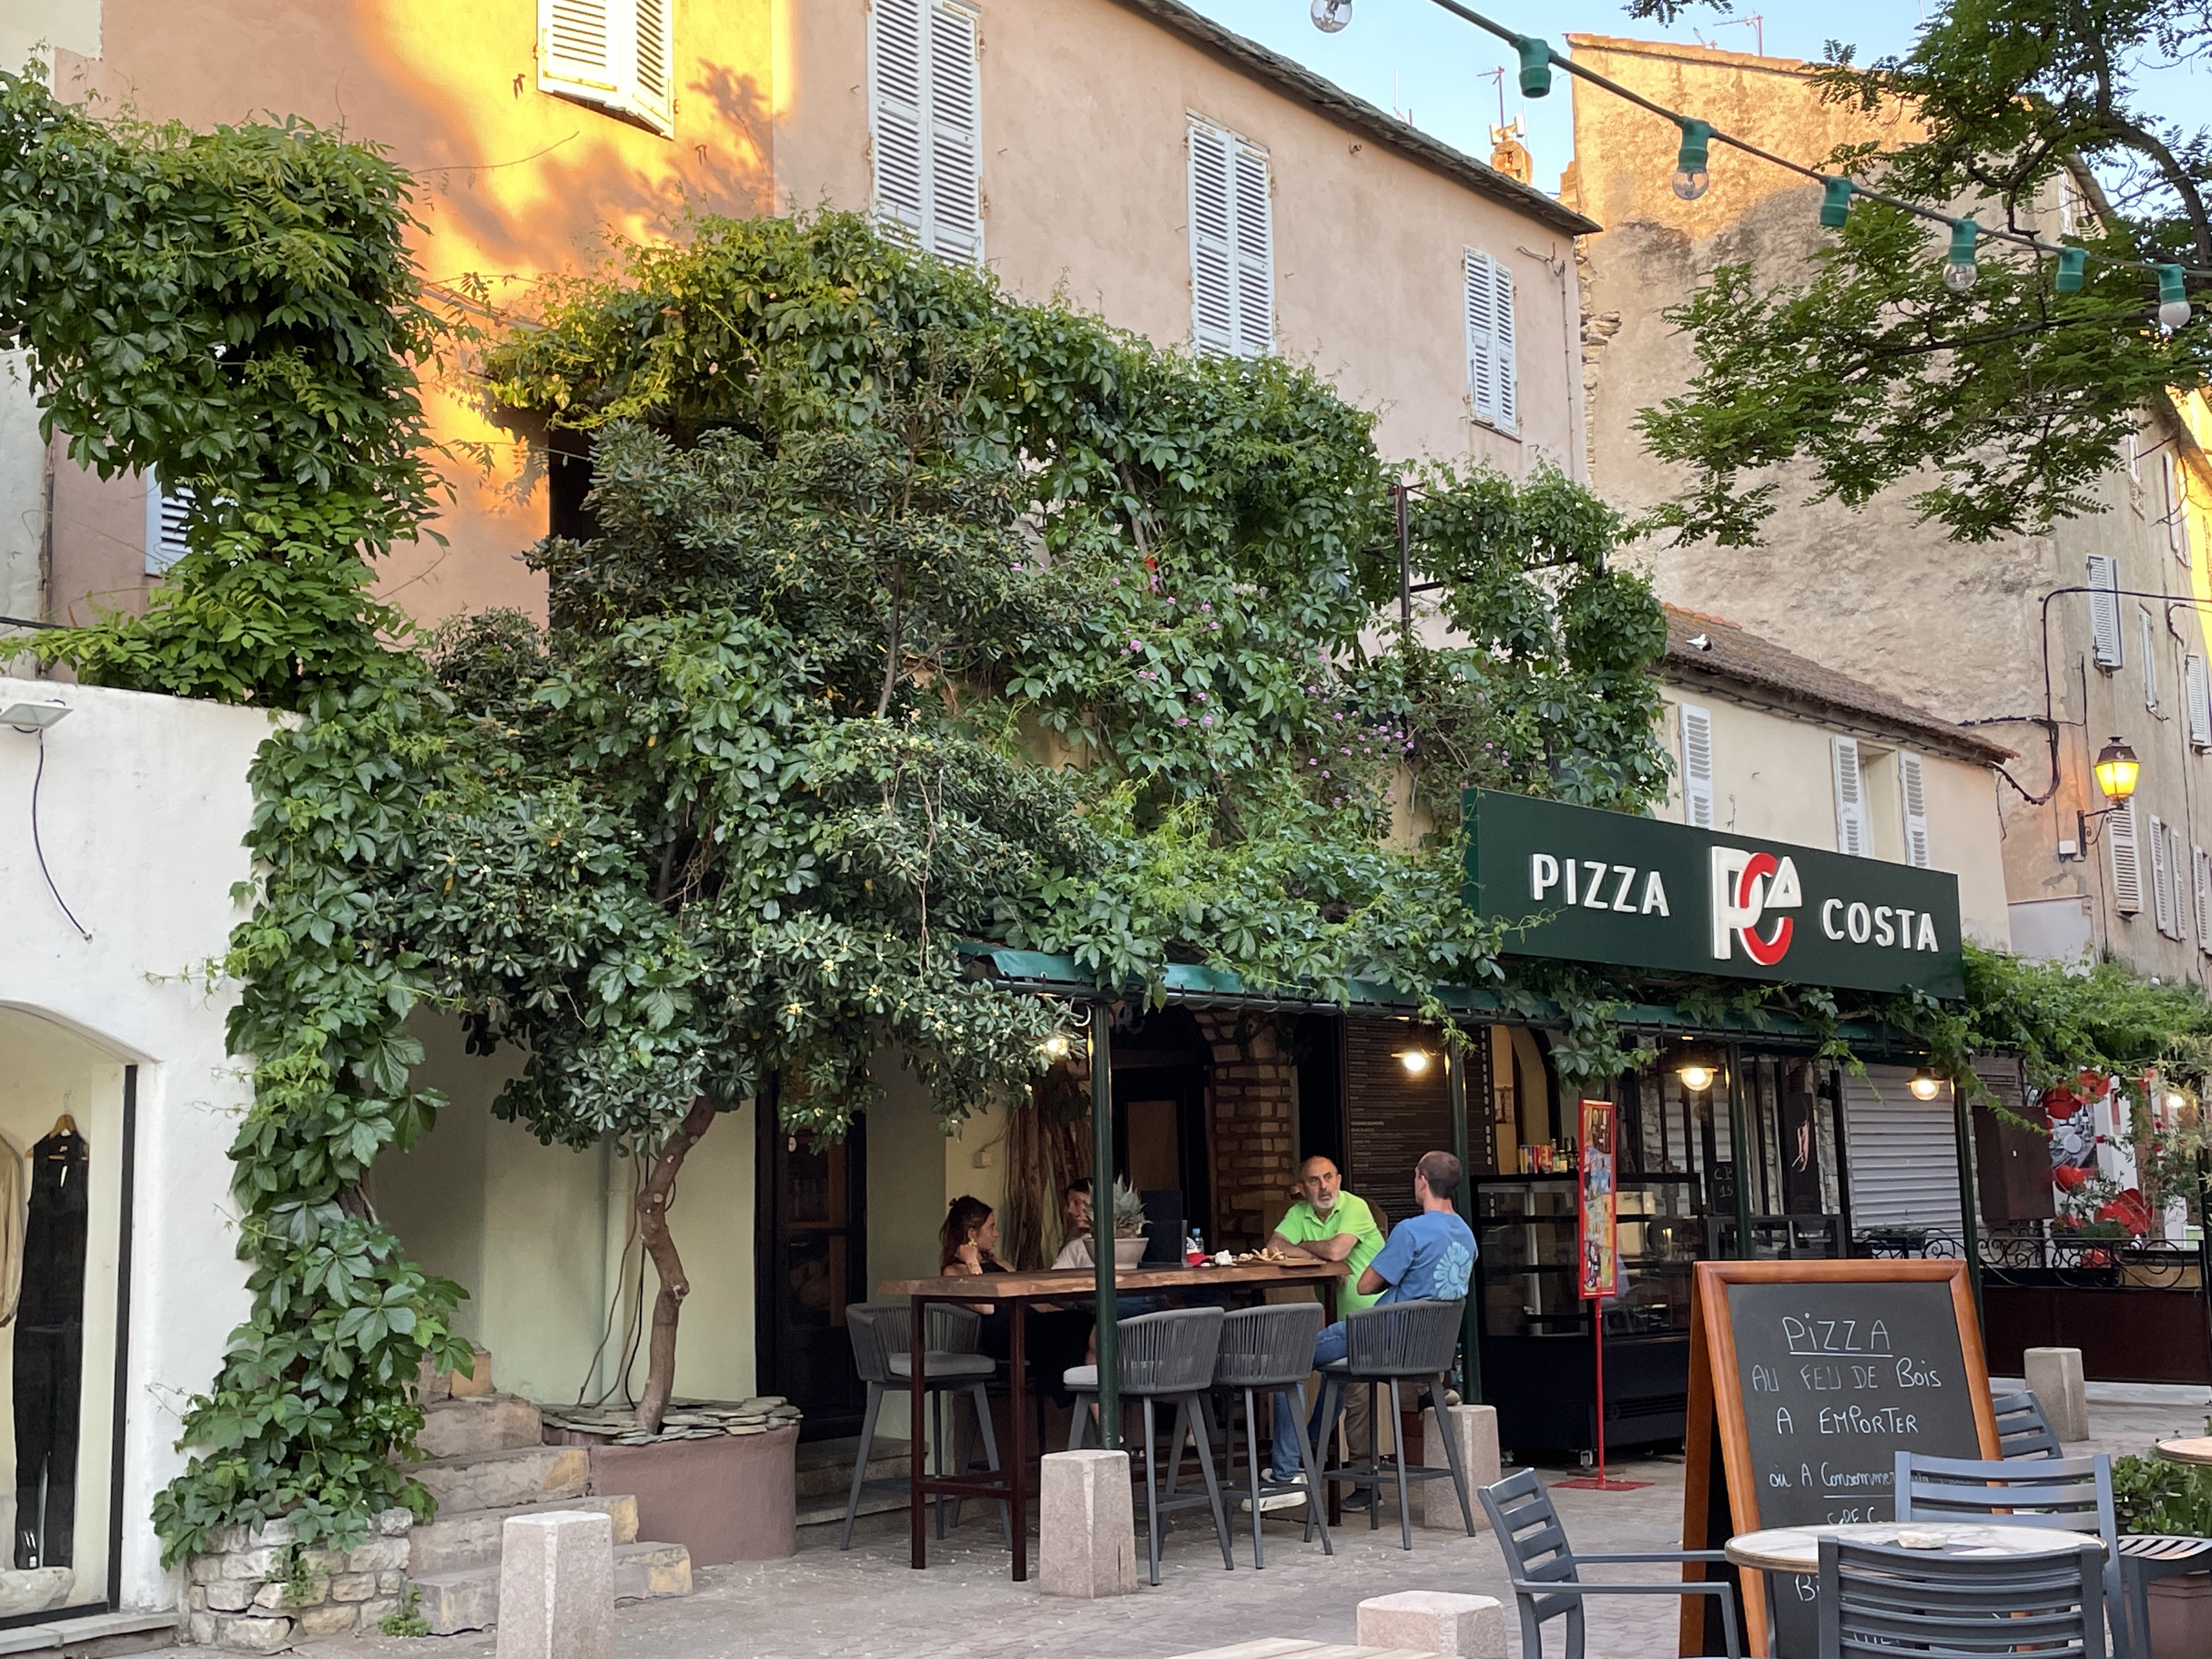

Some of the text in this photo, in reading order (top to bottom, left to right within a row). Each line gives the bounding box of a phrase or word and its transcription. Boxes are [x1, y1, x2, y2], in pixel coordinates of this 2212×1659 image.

[1532, 854, 1670, 917] PIZZA
[1822, 898, 1939, 952] COSTA
[1752, 1364, 1779, 1392] AU
[1800, 1363, 1842, 1391] FEU
[1850, 1365, 1878, 1389] DE
[1776, 1407, 1794, 1435] A
[1801, 1462, 1813, 1487] A
